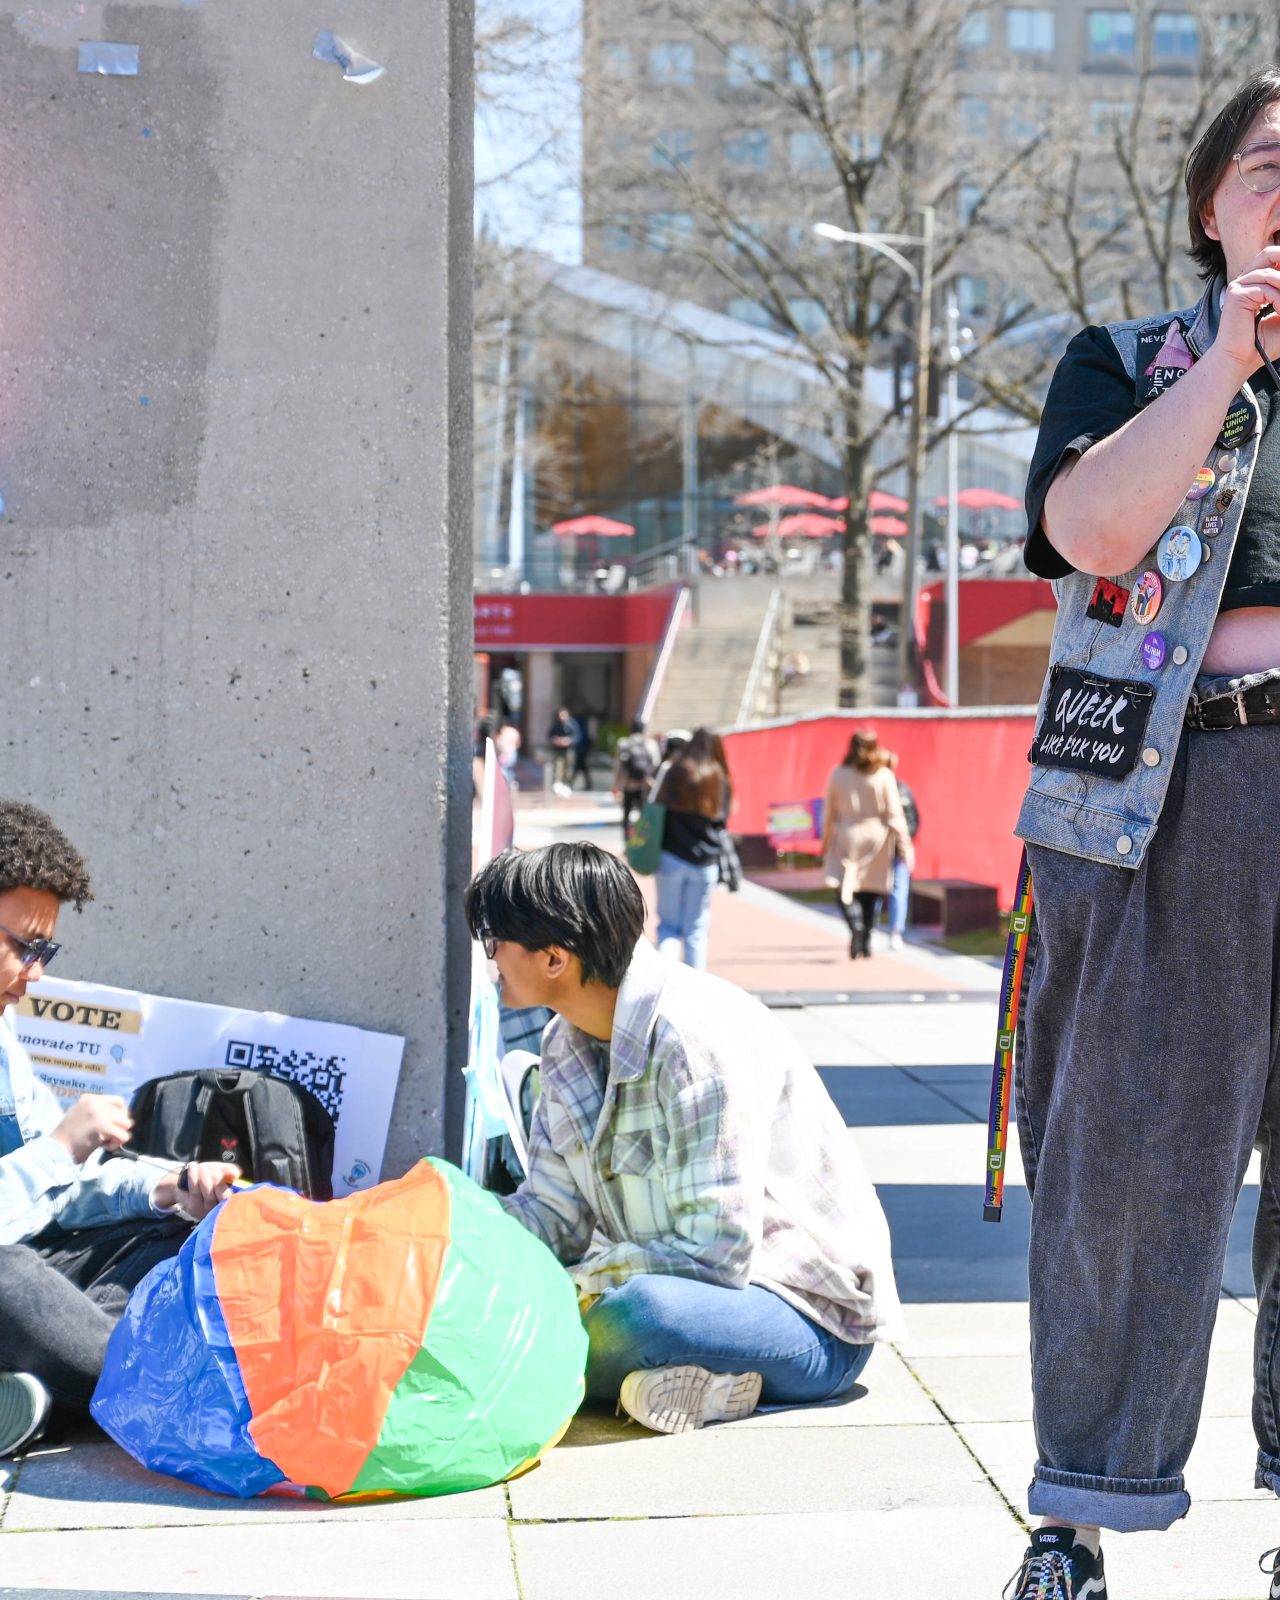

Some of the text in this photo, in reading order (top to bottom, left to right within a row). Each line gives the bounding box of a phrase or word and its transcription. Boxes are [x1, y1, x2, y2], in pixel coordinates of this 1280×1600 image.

[1225, 407, 1248, 421] emple
[1226, 413, 1250, 429] UNION
[1224, 425, 1244, 439] Made
[1054, 687, 1128, 735] QUEER
[1039, 733, 1065, 756] LIKE
[1089, 740, 1125, 764] YOU
[1013, 915, 1028, 933] TD
[1004, 948, 1020, 1013] #ForeverProud
[28, 997, 121, 1030] VOTE
[77, 1041, 101, 1056] TU
[999, 1031, 1011, 1050] TD
[993, 1067, 1007, 1132] #ForeverProud
[989, 1151, 1003, 1169] TD
[1039, 1534, 1058, 1543] VANS
